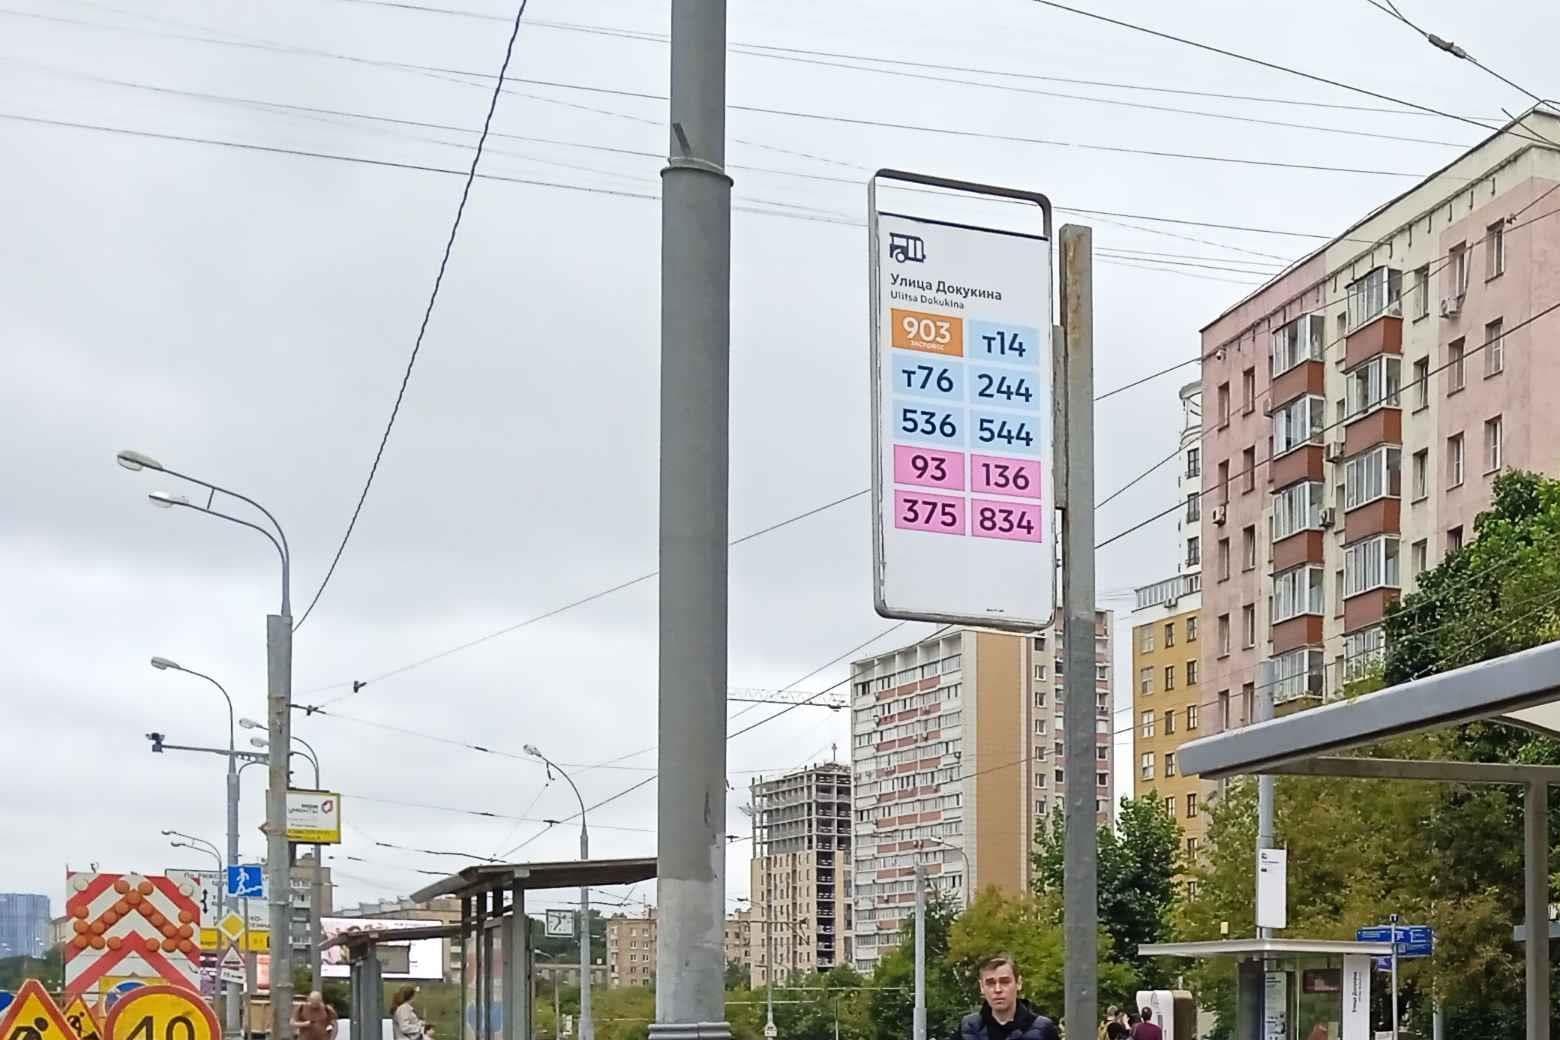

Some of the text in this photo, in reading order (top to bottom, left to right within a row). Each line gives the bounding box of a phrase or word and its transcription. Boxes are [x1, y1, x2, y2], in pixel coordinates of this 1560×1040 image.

[891, 273, 1003, 300] Улица Докукина
[891, 290, 964, 309] Ulitsa Dokukina
[902, 316, 951, 344] 903
[977, 373, 1033, 402] 244
[902, 408, 957, 437] 536
[978, 418, 1034, 446] 544
[911, 454, 947, 481] 93
[982, 463, 1030, 490] 136
[902, 498, 957, 527] 375
[979, 507, 1035, 535] 834
